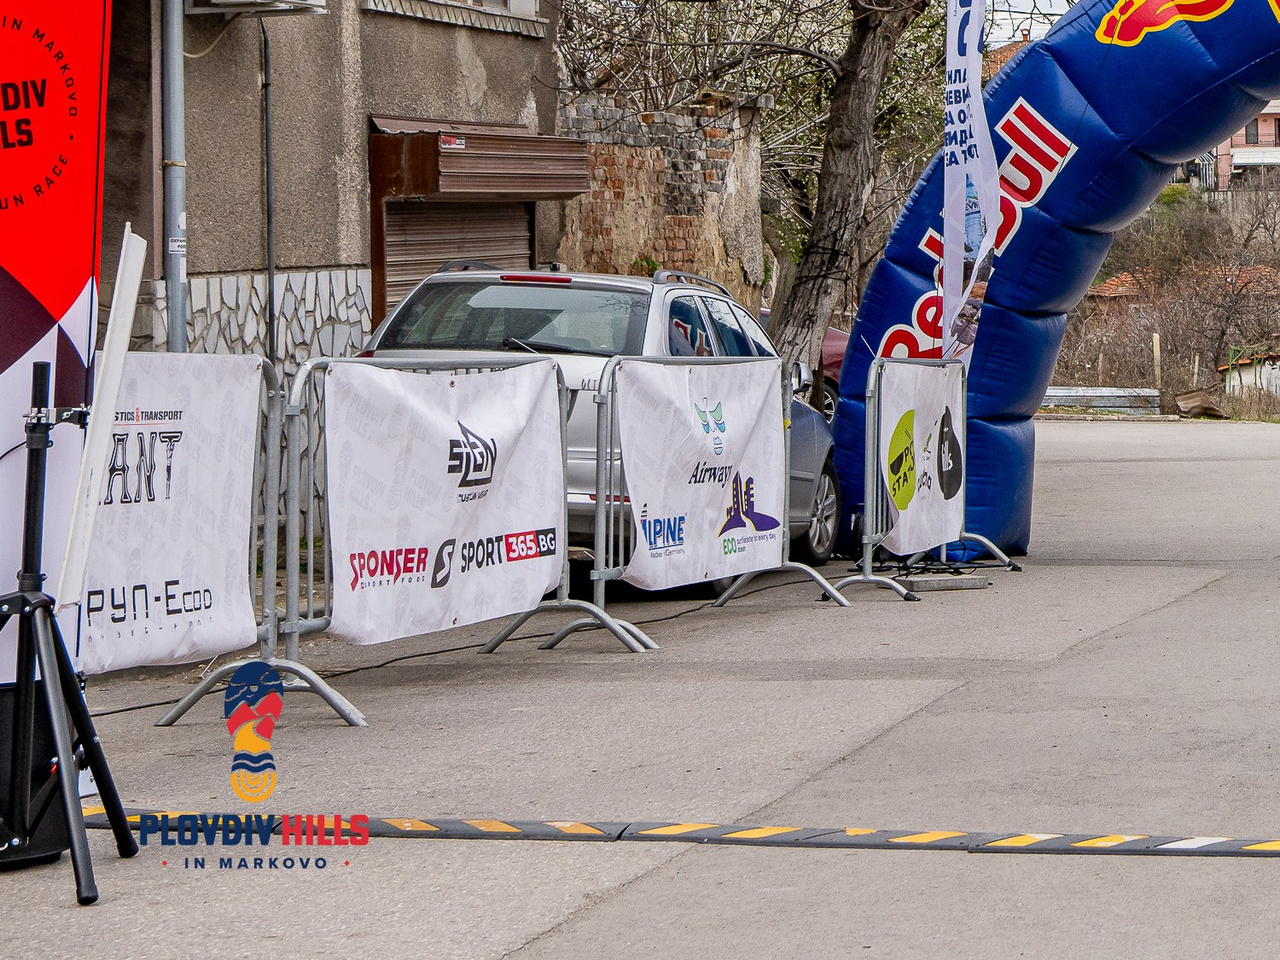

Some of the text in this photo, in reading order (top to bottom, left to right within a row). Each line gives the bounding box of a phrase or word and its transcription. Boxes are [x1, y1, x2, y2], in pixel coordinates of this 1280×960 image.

[2, 16, 78, 117] IN MARKOVO
[0, 154, 69, 210] UN RACE
[114, 411, 135, 422] STICS
[140, 410, 184, 421] TRANSPORT
[103, 431, 183, 506] ANT
[349, 547, 429, 592] SPONSER
